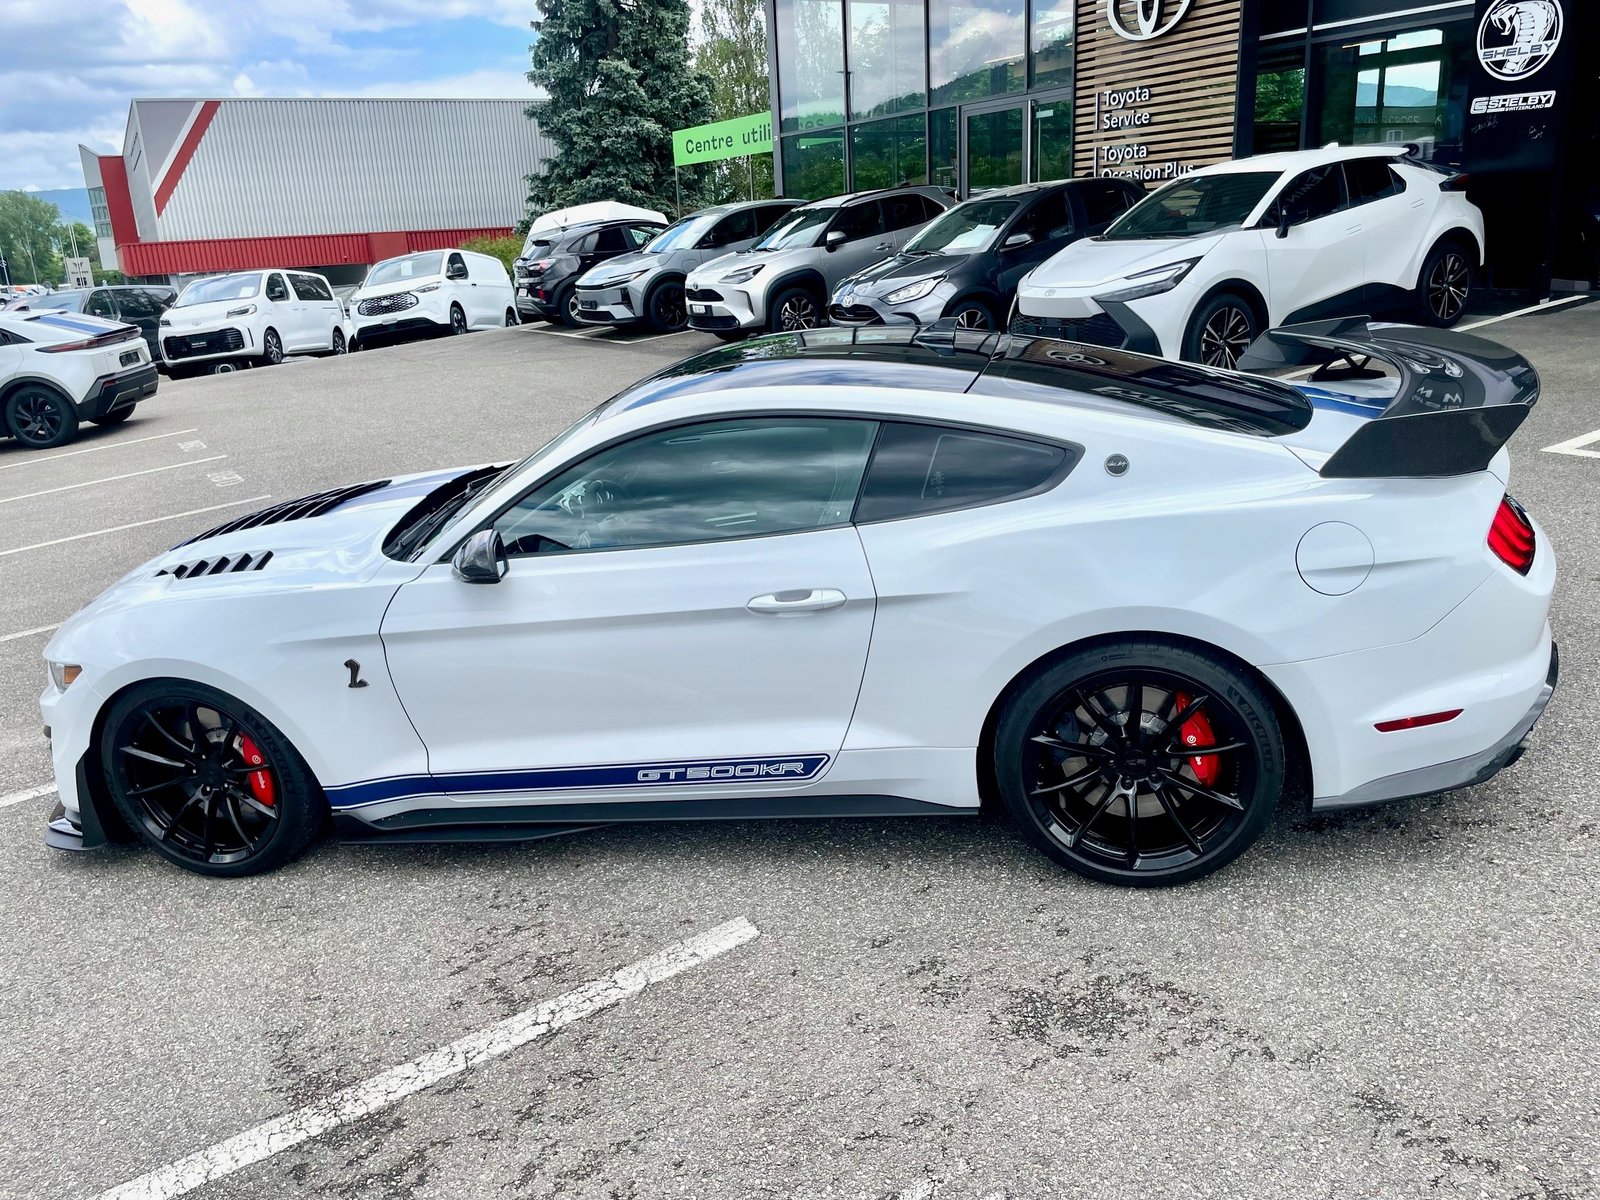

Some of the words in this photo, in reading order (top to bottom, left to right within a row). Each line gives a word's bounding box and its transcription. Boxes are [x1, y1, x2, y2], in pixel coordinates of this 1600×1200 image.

[1482, 42, 1555, 60] SHELBY
[1104, 86, 1150, 109] Toyota
[1488, 95, 1551, 108] SHELBY
[1504, 104, 1545, 112] SWITZERLAND
[1103, 110, 1150, 129] Service
[685, 135, 734, 155] Centre
[1102, 144, 1148, 164] Toyota
[1101, 165, 1161, 180] Occasion
[1164, 161, 1194, 178] Plus
[637, 762, 805, 781] GT500KR
